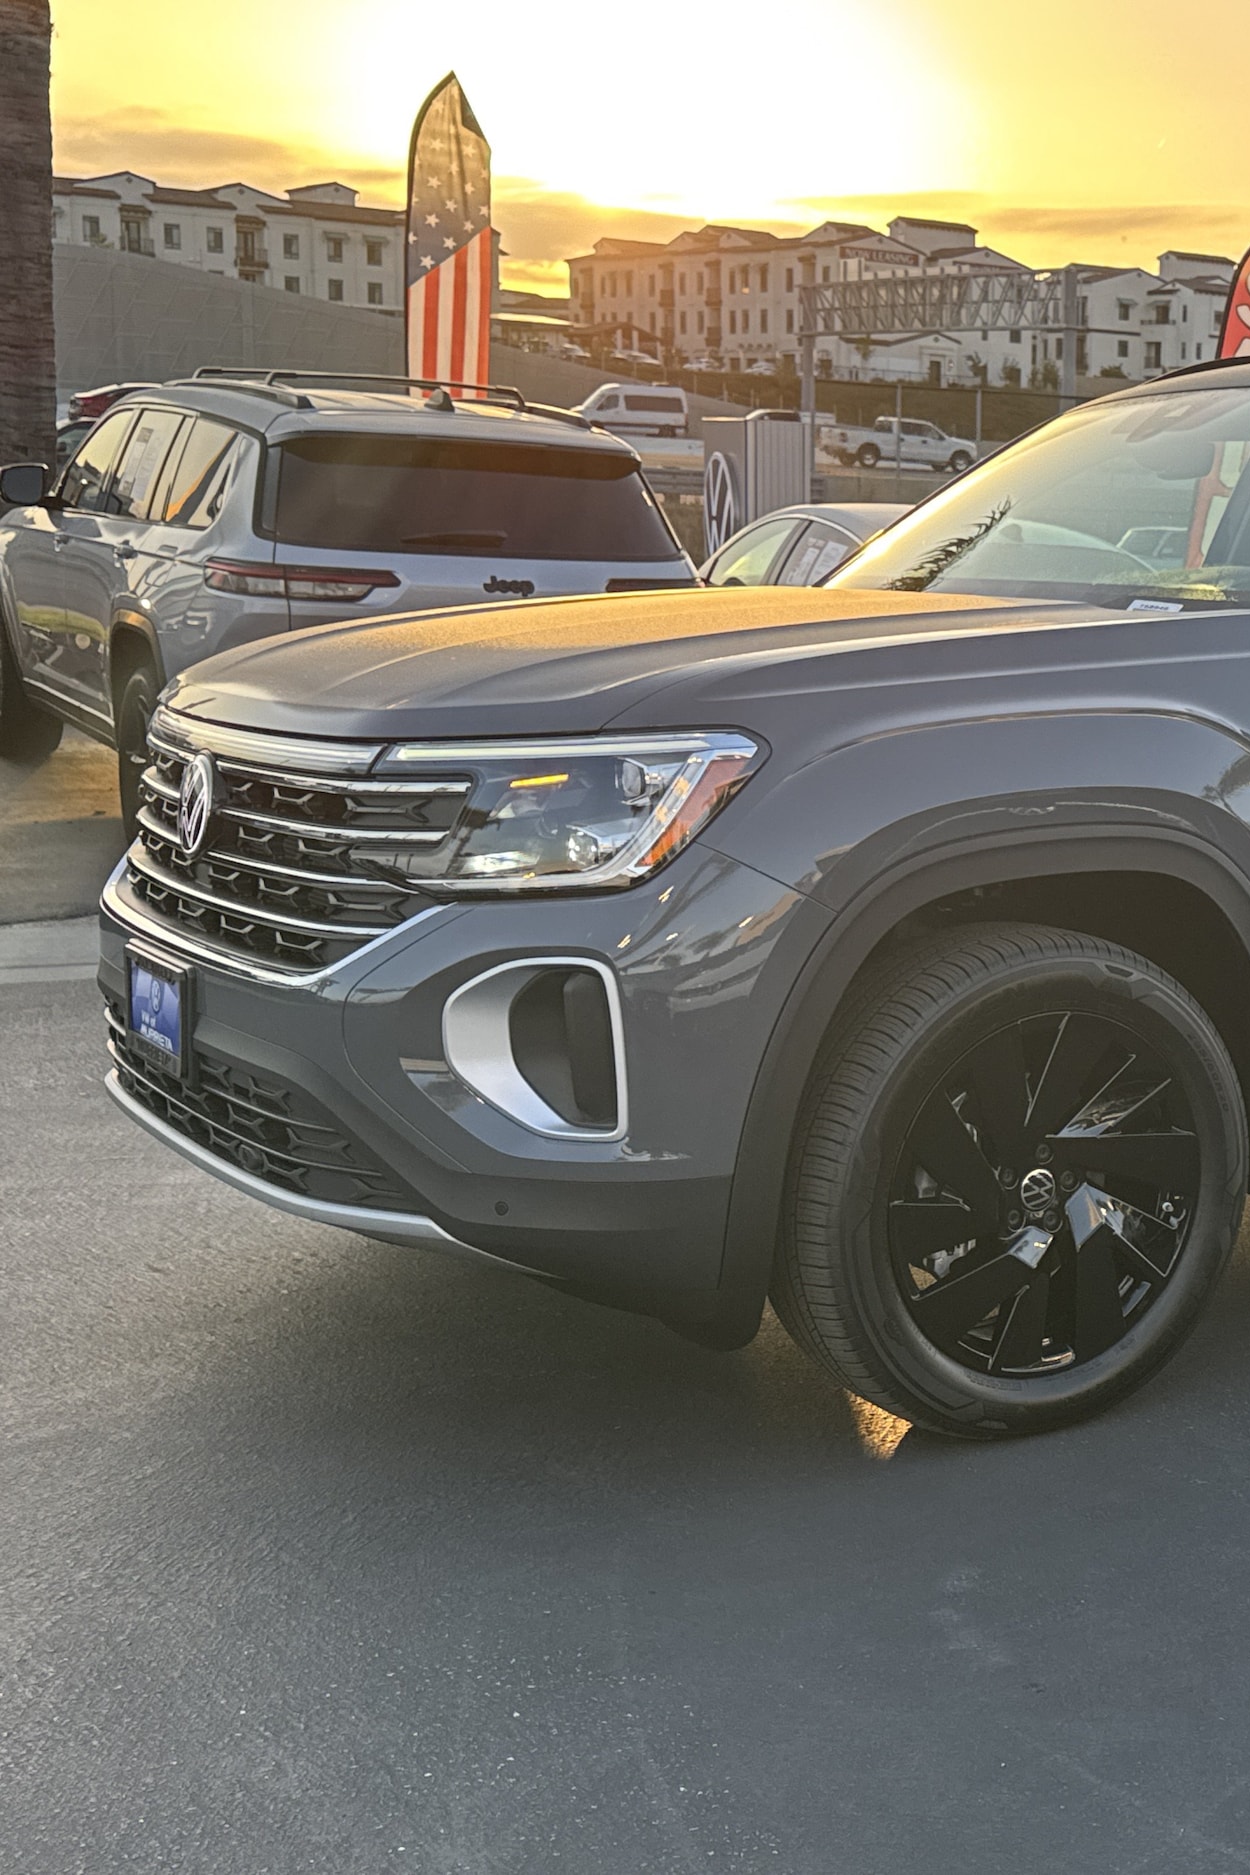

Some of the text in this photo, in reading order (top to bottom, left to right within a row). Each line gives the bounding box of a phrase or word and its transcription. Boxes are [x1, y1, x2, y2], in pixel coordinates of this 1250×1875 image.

[845, 248, 914, 265] NOW LEASING
[483, 575, 535, 597] Jeep
